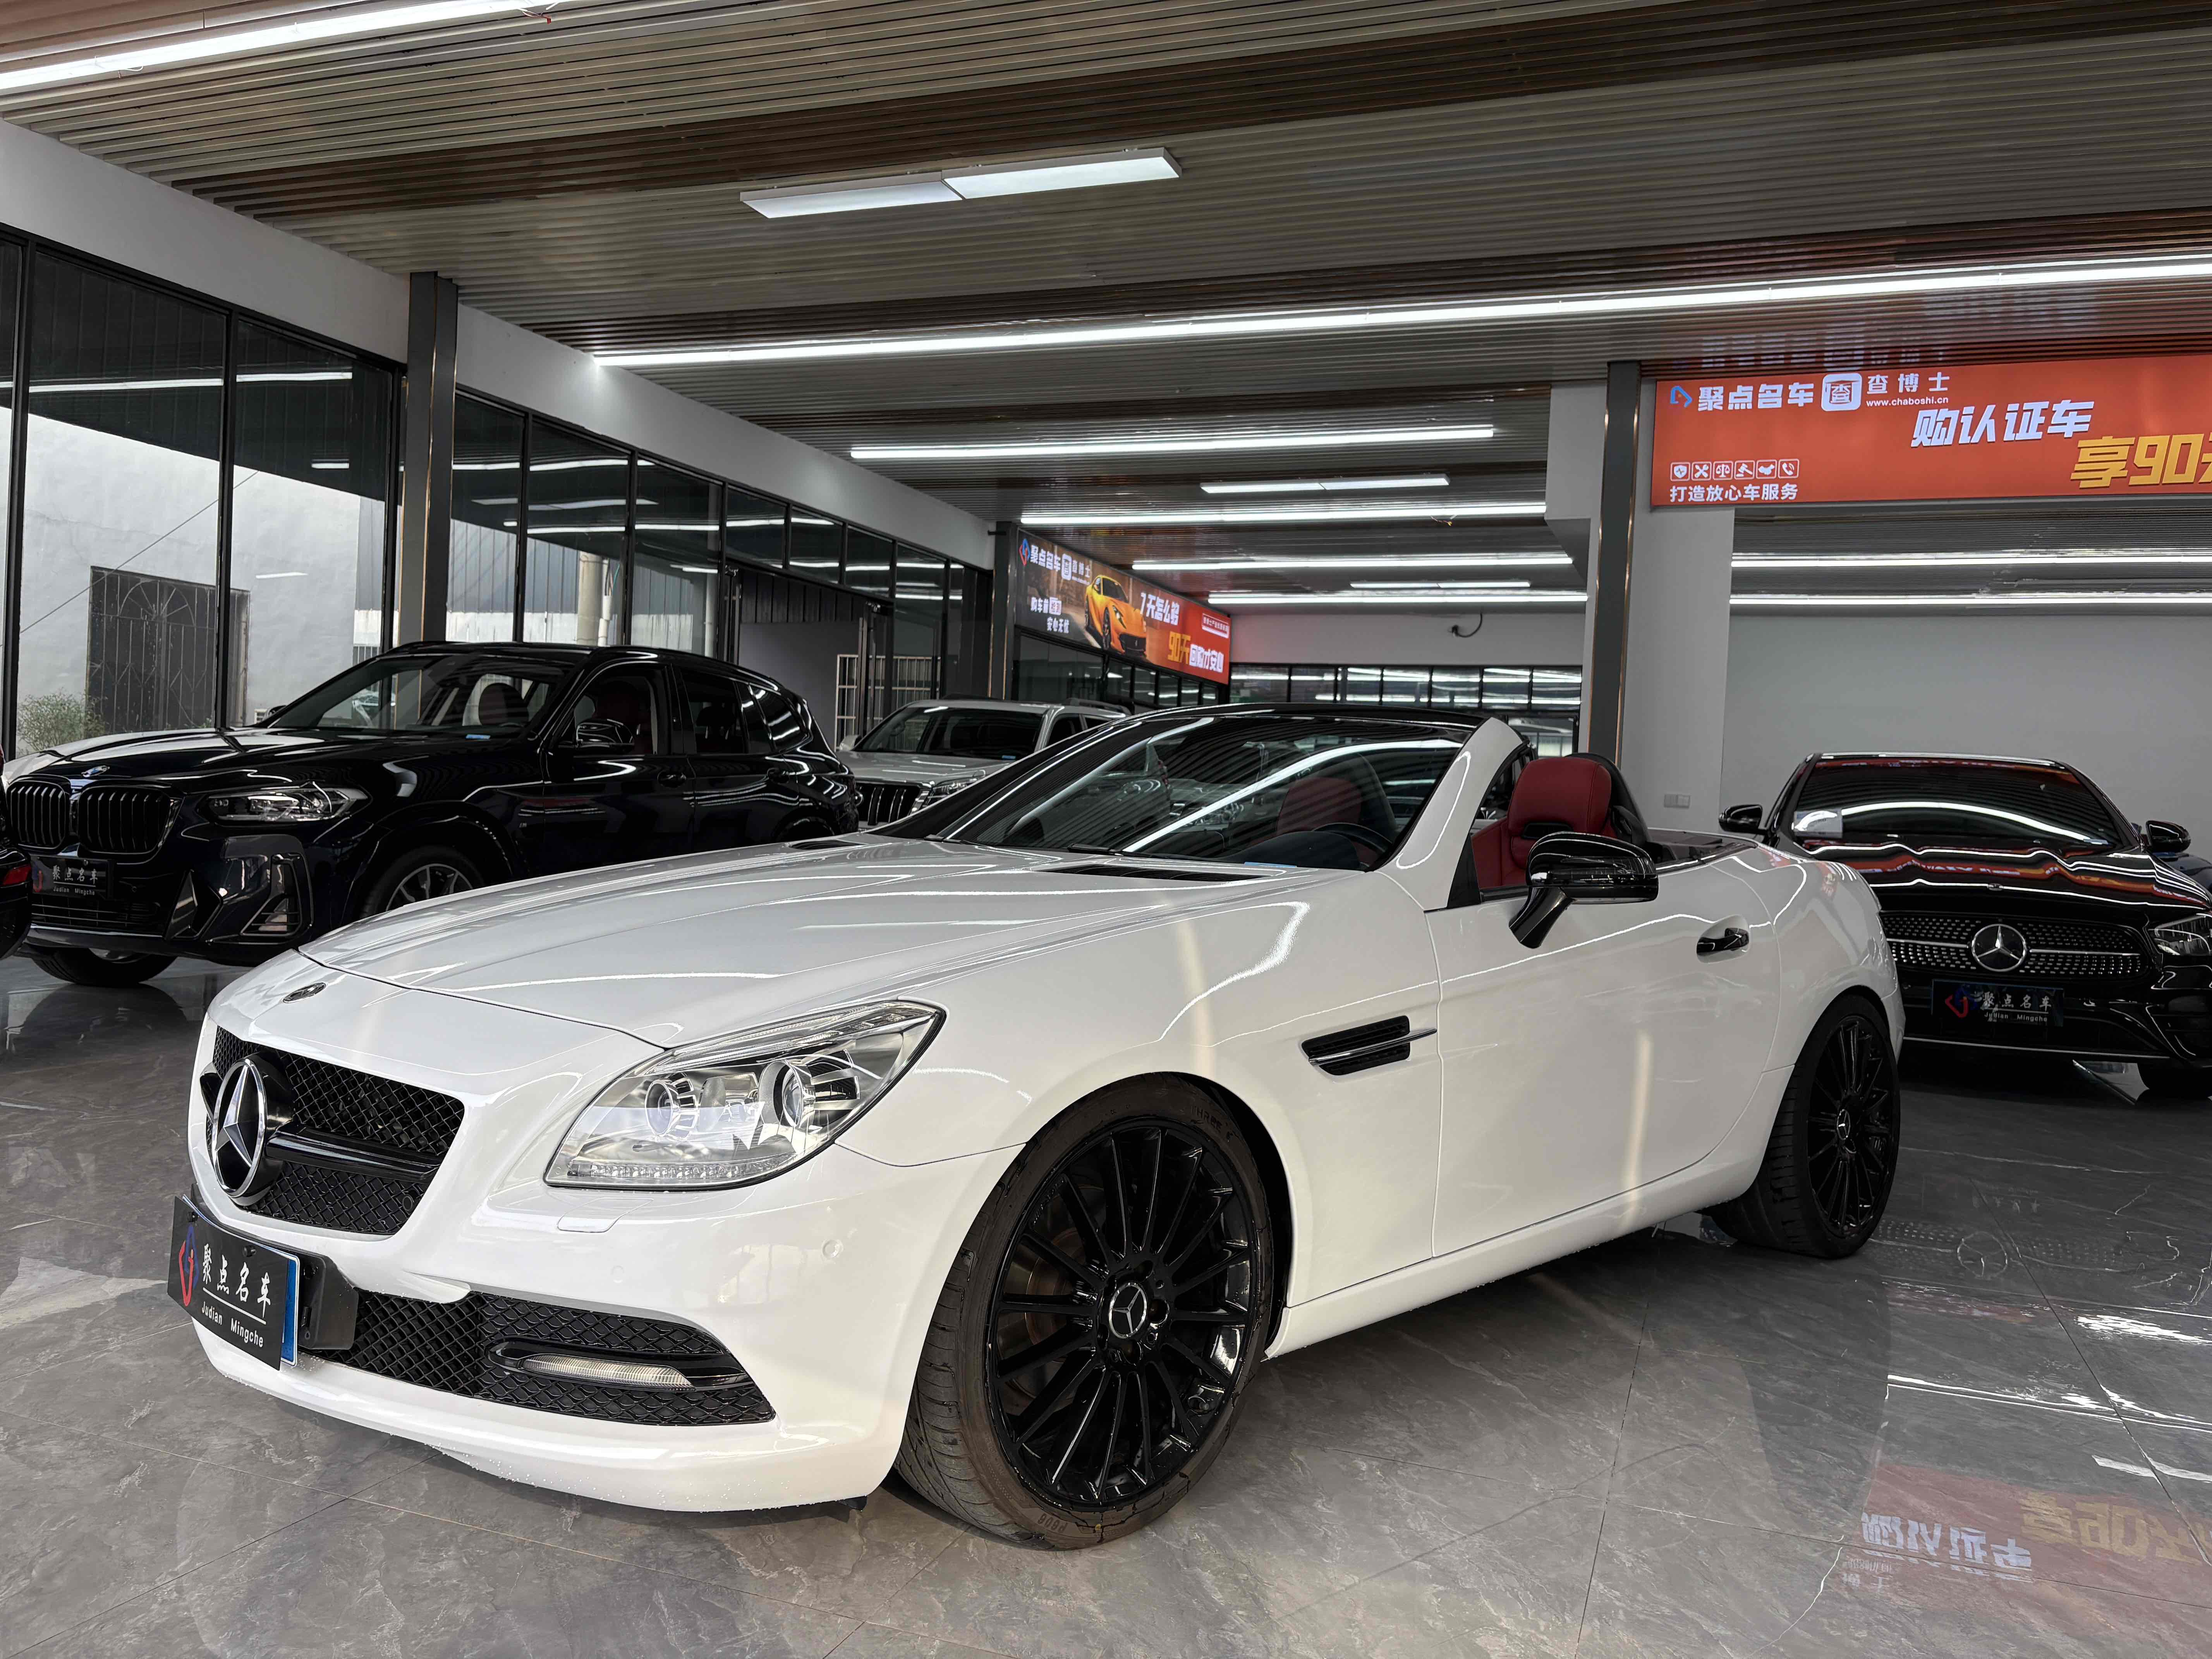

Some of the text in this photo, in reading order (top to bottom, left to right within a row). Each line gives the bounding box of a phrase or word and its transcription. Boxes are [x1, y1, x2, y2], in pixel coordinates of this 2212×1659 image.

[1698, 382, 1814, 411] 聚点名车
[1867, 372, 1949, 394] 查博士
[1866, 396, 1948, 407] www.chaboshi.cn
[1911, 399, 2094, 447] 购认证车
[1670, 483, 1798, 502] 打造放心车服务
[202, 1243, 271, 1318] 聚点名车
[202, 1301, 264, 1348] Judian Mingche
